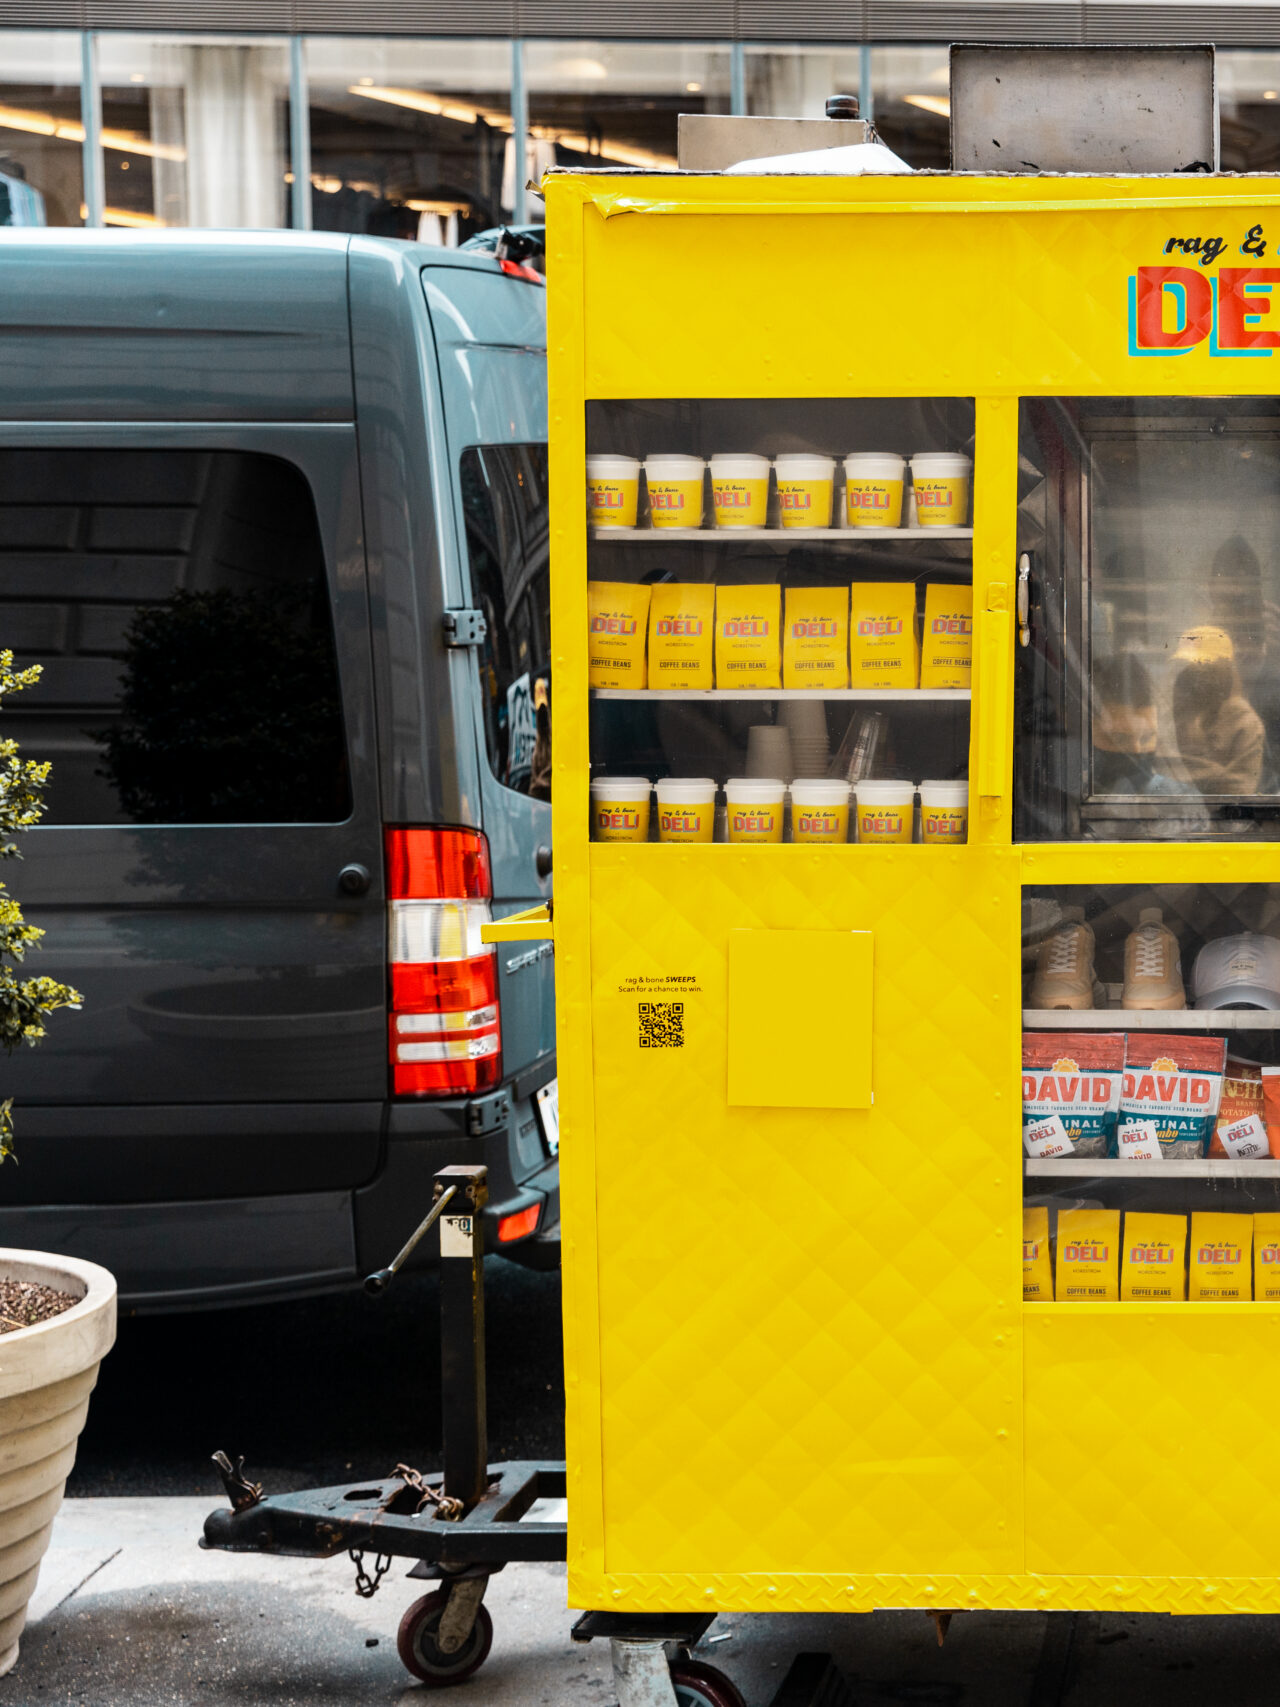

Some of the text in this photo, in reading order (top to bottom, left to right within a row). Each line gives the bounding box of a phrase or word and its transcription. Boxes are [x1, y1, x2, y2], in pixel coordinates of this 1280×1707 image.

[1163, 237, 1228, 266] rag
[1239, 224, 1267, 259] &
[850, 493, 890, 510] DELI
[916, 491, 953, 508] DELI
[591, 616, 637, 636] DELI
[657, 620, 703, 637] DELI
[723, 621, 769, 638] DELI
[792, 622, 837, 639] DELI
[858, 619, 903, 637] DELI
[590, 658, 632, 668] COFFEE BEANS
[726, 662, 746, 670] COFFEE
[794, 662, 814, 670] COFFEE
[862, 660, 882, 668] COFFEE
[932, 658, 953, 666] COFFEE
[600, 814, 640, 830] DELI
[661, 816, 701, 833] DELI
[733, 816, 774, 833] DELI
[799, 817, 840, 834] DELI
[862, 818, 902, 834] DELI
[1021, 1076, 1111, 1103] DAVID
[1122, 1074, 1211, 1104] DAVID
[1029, 1127, 1056, 1142] DELI
[1122, 1131, 1148, 1144] DELI
[1227, 1125, 1255, 1142] DELI
[1040, 1145, 1063, 1158] DAVID
[1064, 1246, 1108, 1262] DELI
[1130, 1247, 1174, 1264] DELI
[1198, 1248, 1242, 1265] DELI
[1132, 1288, 1152, 1296] COFFEE
